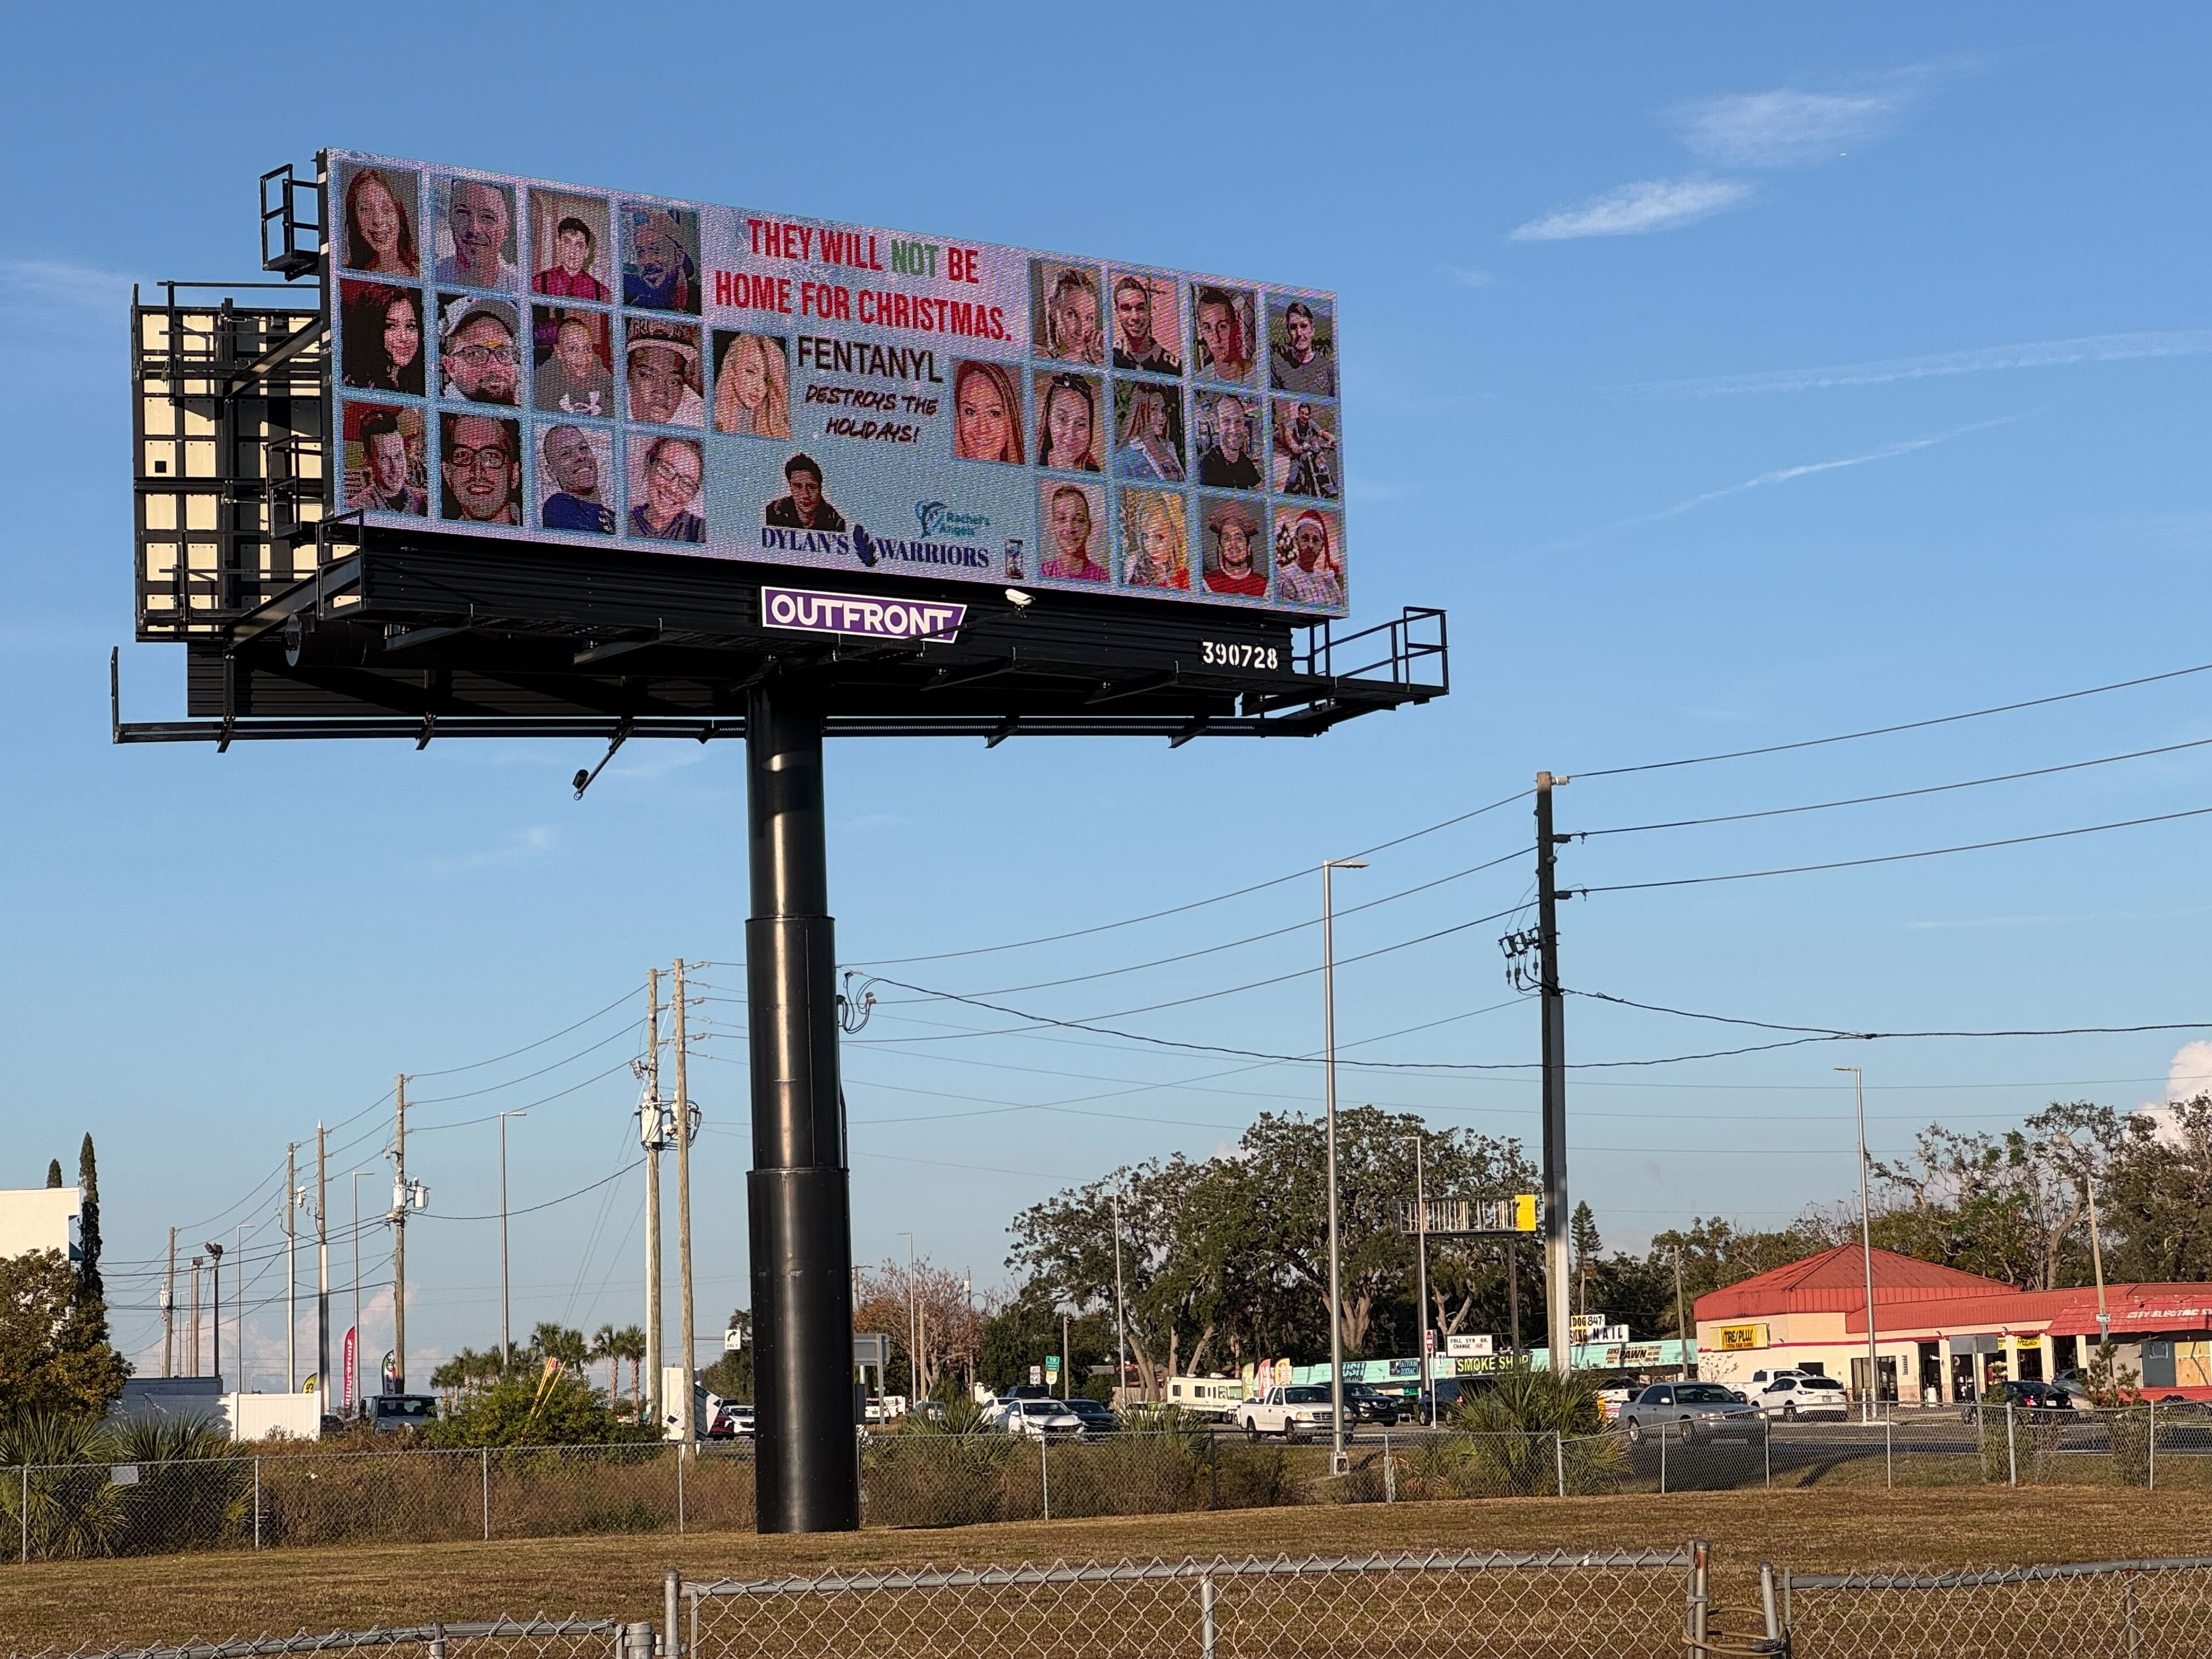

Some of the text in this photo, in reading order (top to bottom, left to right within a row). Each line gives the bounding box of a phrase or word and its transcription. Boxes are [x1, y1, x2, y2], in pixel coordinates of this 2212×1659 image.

[747, 219, 979, 284] THEY WILL NOT BE
[715, 271, 1012, 341] HOME FOR CHRISTMAS.
[798, 336, 943, 383] FENTANYL
[806, 385, 939, 415] DESTROYS THE
[827, 417, 919, 443] HOLIDAYS!
[761, 528, 989, 567] DYLAN'S WARRIORS
[771, 594, 953, 637] OUTFRONT
[1203, 641, 1278, 670] 390728
[1572, 1317, 1586, 1327] DOG
[2152, 1308, 2199, 1317] ELECTRIC
[1457, 1355, 1528, 1372] SMOKE SHP
[1619, 1350, 1647, 1359] PAWN
